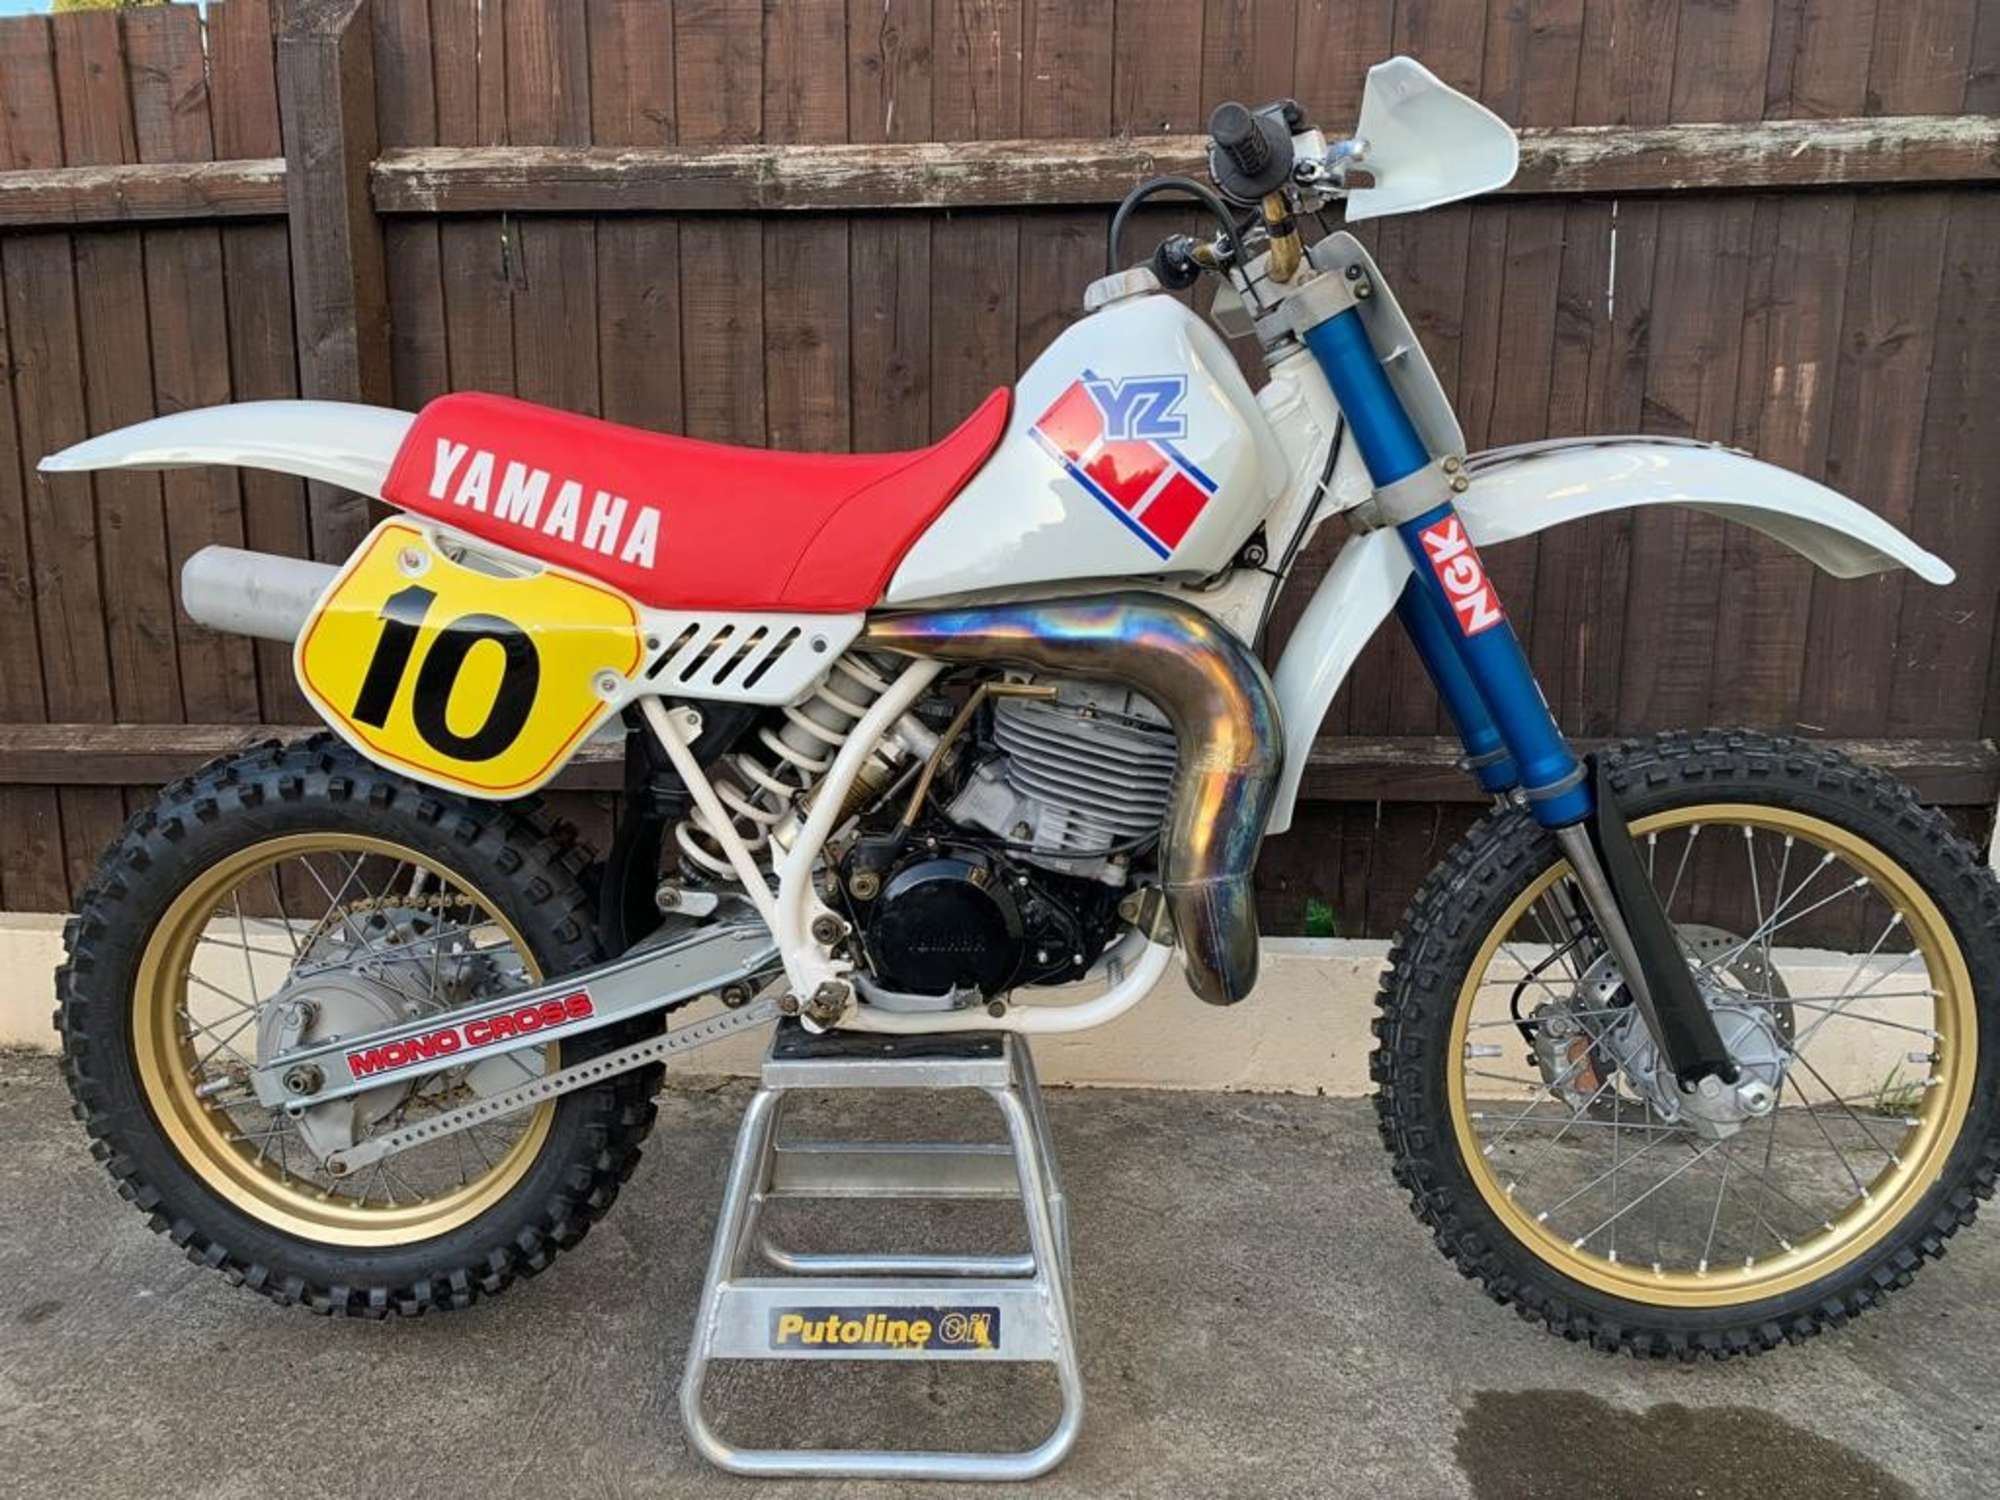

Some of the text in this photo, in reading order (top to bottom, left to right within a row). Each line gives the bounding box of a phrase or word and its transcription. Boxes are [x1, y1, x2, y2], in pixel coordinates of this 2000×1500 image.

[1083, 374, 1188, 441] YZ
[428, 437, 661, 569] YAMAHA
[1423, 518, 1501, 632] NGK
[351, 584, 540, 762] 10
[348, 991, 593, 1077] MONO CROSS
[776, 1313, 932, 1344] Putoline
